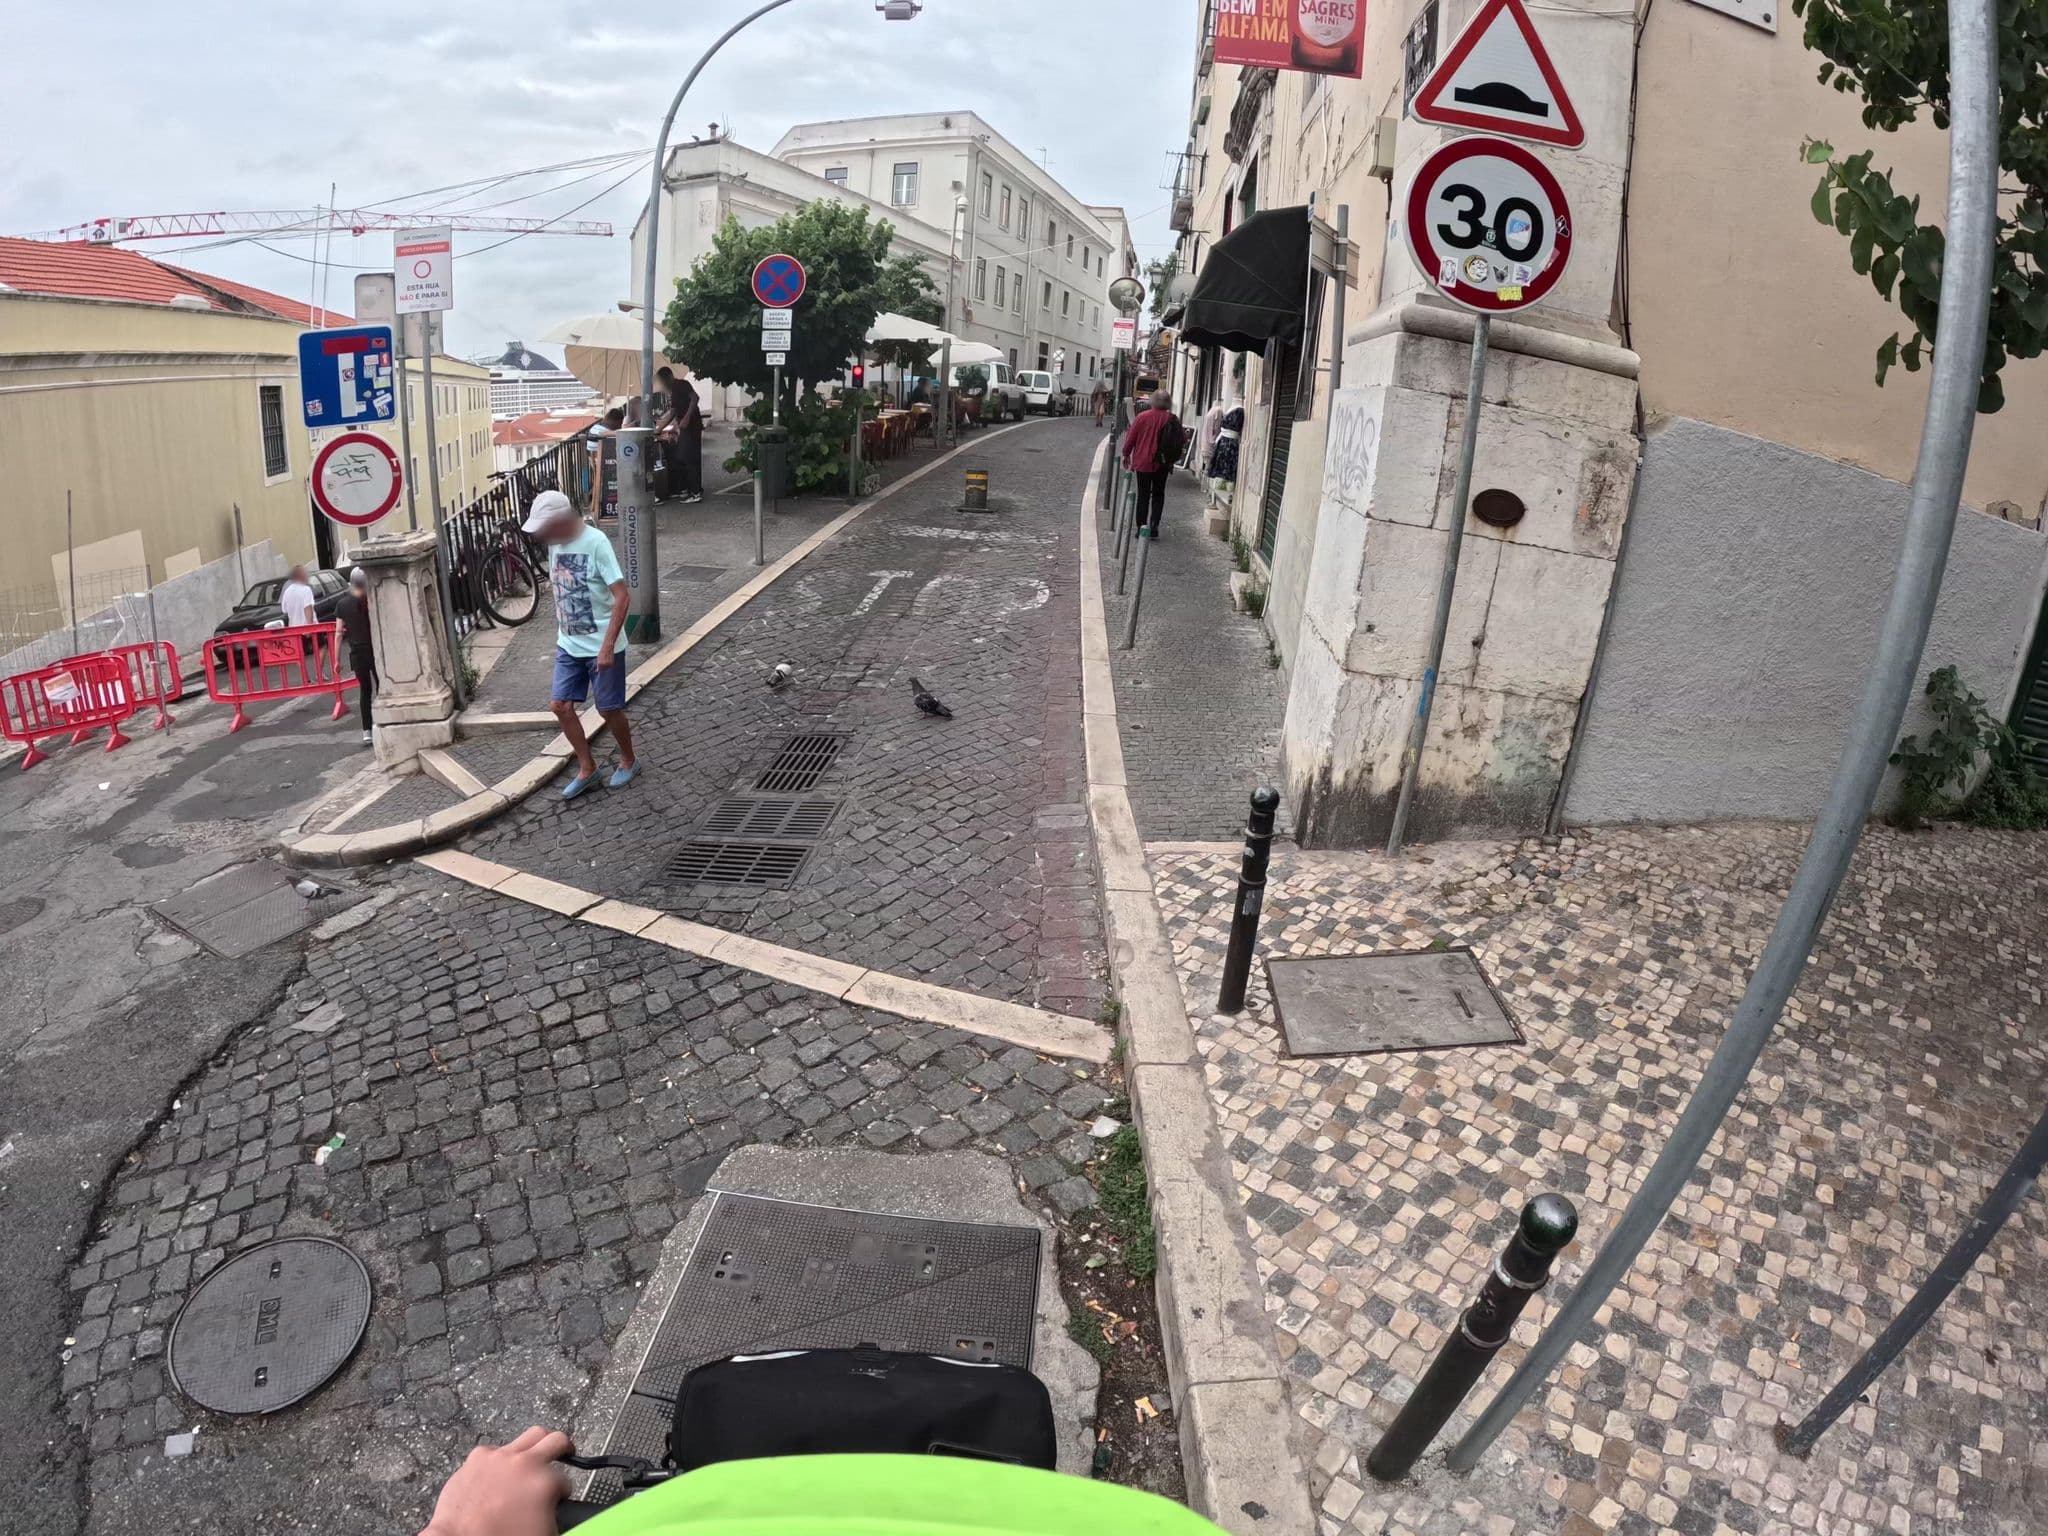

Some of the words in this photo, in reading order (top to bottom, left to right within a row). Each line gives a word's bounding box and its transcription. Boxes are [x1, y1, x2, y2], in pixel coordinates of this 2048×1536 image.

[1262, 0, 1287, 18] EM
[1300, 0, 1354, 20] SAGRES
[1218, 13, 1289, 43] ALFAMA
[1437, 183, 1544, 262] 30
[628, 505, 638, 589] CONDICIONADO
